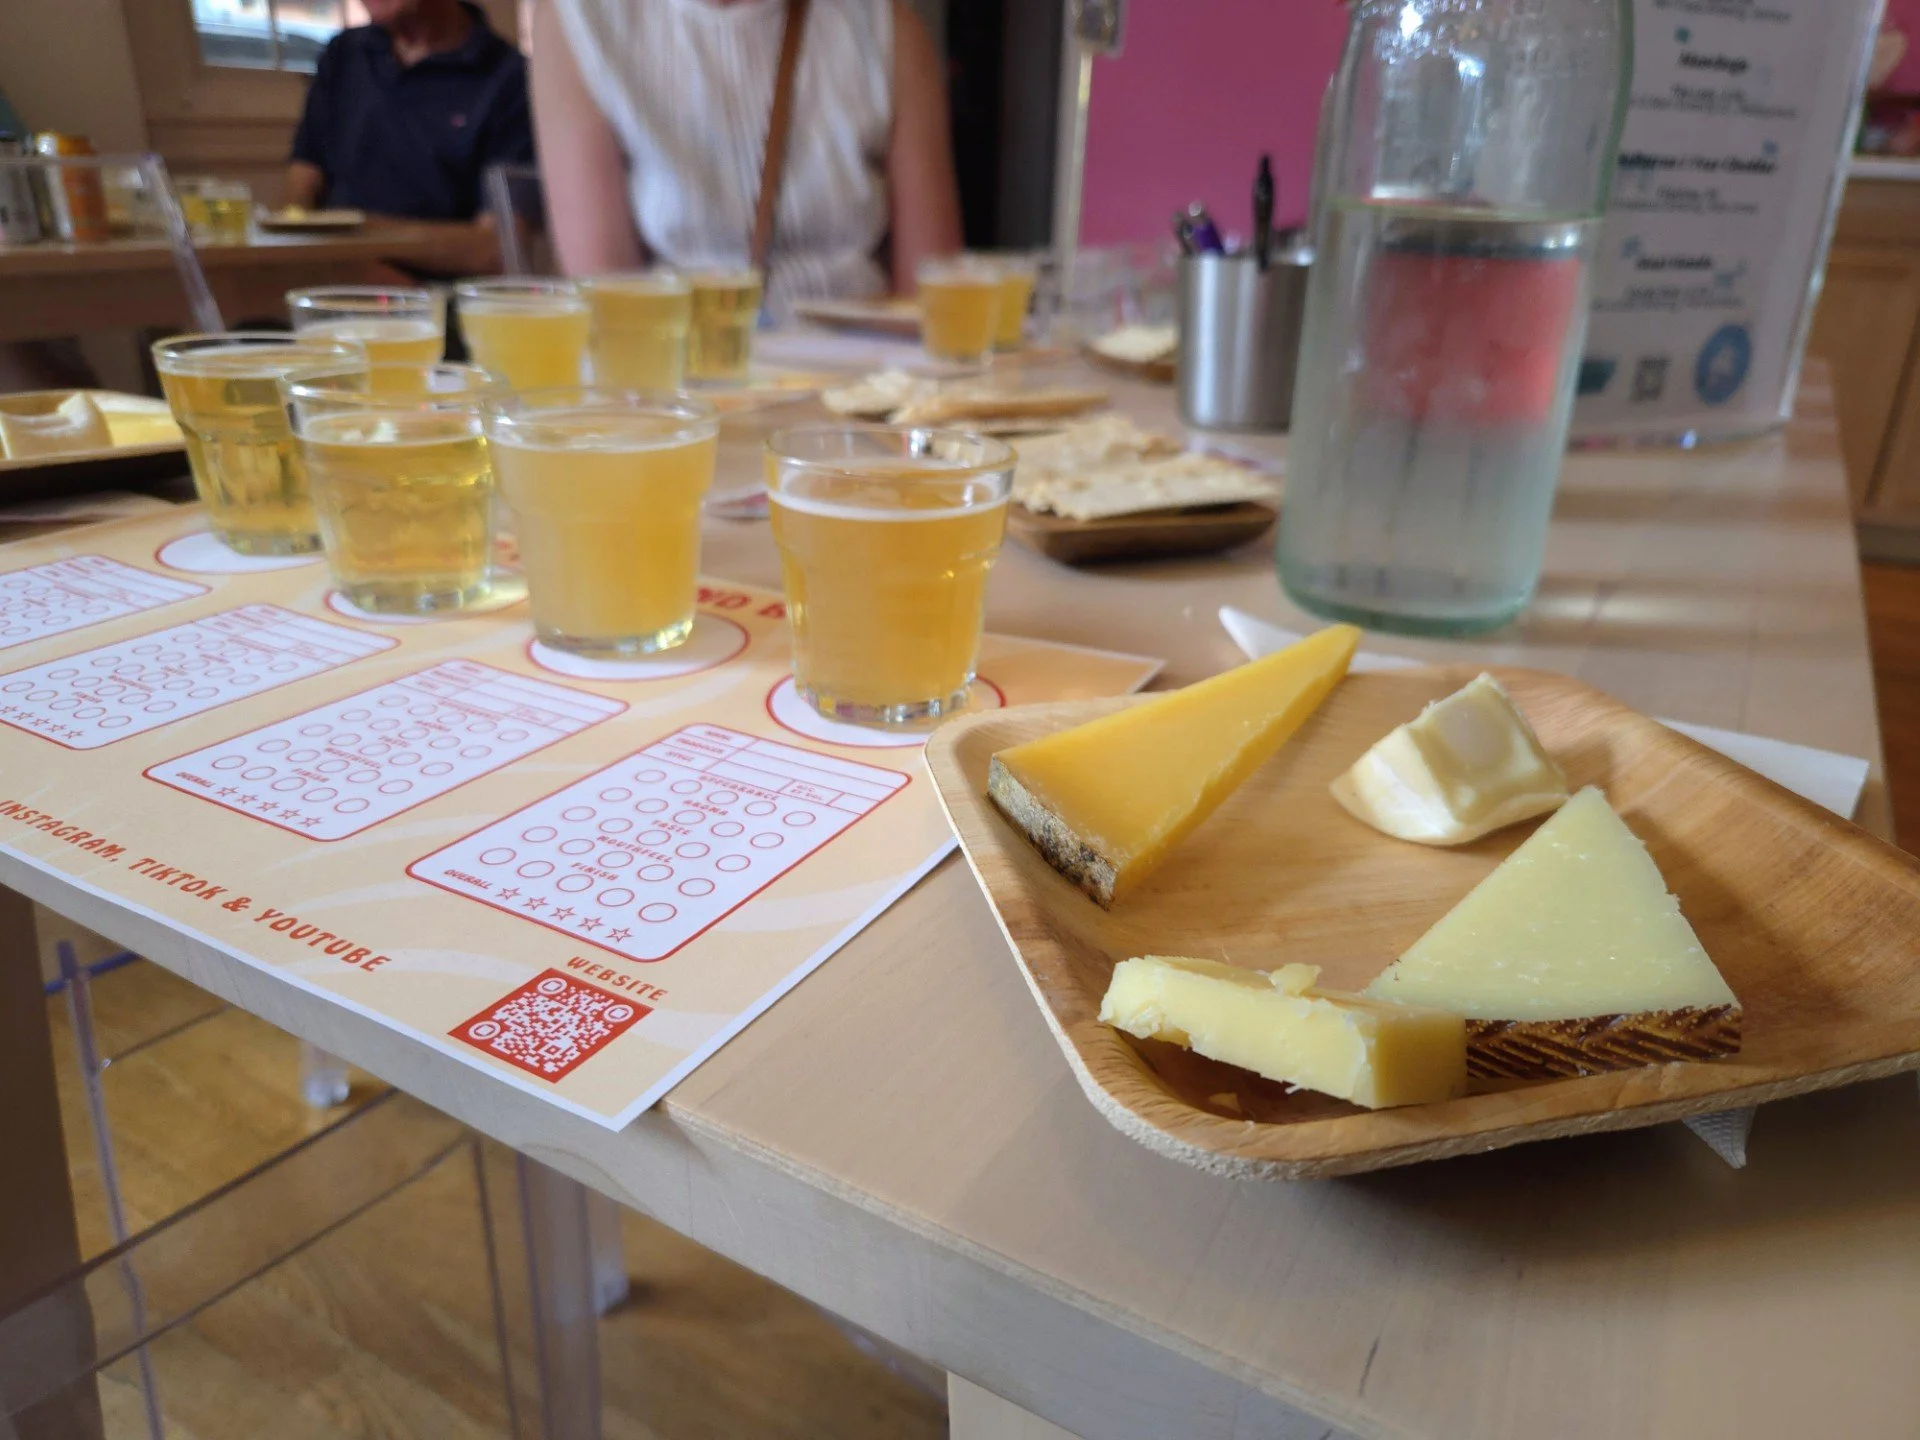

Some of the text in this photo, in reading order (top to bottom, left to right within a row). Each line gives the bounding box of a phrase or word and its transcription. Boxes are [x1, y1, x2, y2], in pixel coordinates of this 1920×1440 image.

[652, 819, 693, 836] TASTE
[597, 834, 673, 864] MOUTHFEEL
[444, 868, 493, 890] OVERALL
[571, 862, 619, 881] FINISH
[128, 857, 228, 901] TIKTOK
[221, 896, 252, 912] &
[253, 908, 393, 972] YOUTUBE
[567, 956, 669, 1001] WEBSITE
